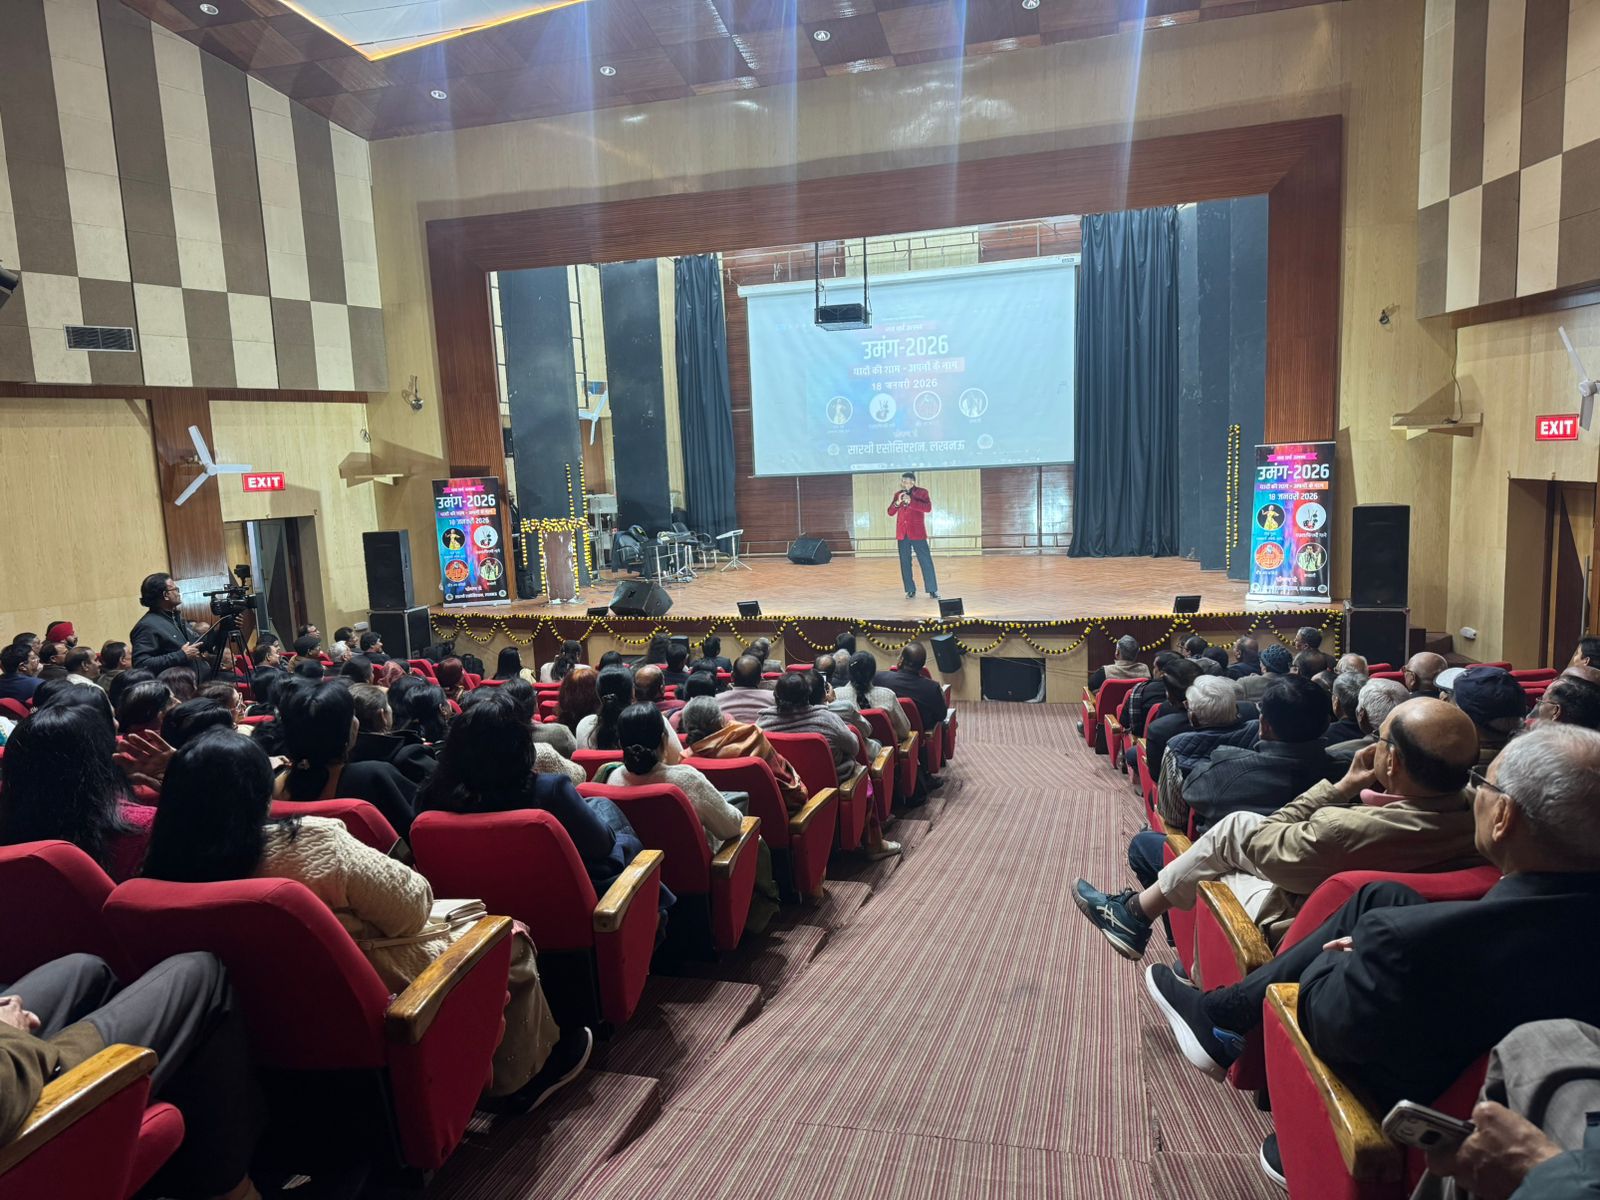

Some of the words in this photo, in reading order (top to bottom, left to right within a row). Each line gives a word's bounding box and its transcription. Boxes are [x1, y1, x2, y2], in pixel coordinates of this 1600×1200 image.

[861, 334, 948, 359] उमंग-2026
[872, 382, 881, 391] 18
[913, 378, 938, 388] 2026
[1540, 420, 1574, 435] EXIT
[1257, 462, 1330, 480] उमंग-2026
[247, 476, 281, 488] EXIT
[435, 493, 496, 509] उमंग-2026
[1300, 492, 1318, 500] 2026
